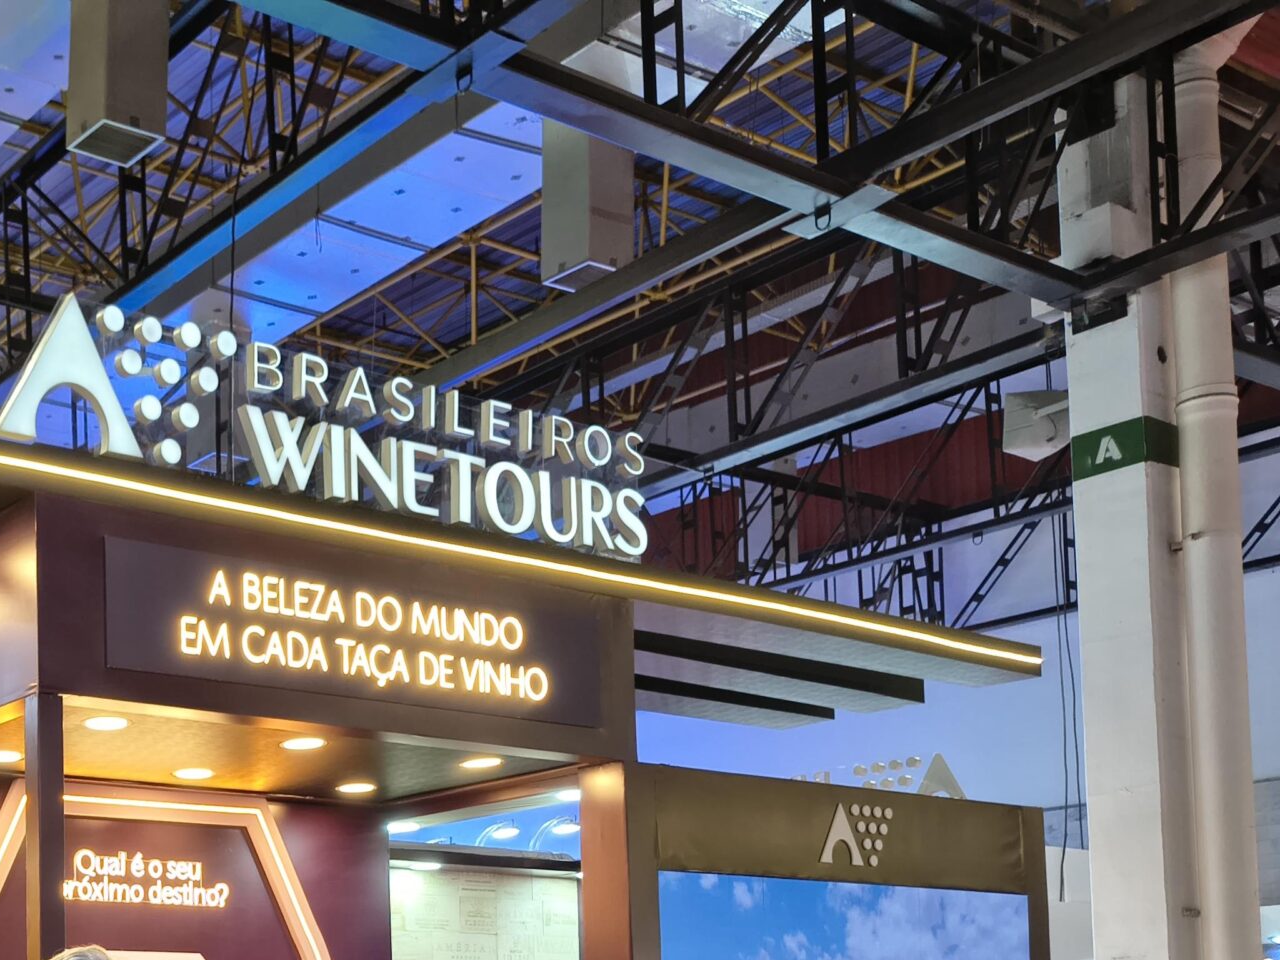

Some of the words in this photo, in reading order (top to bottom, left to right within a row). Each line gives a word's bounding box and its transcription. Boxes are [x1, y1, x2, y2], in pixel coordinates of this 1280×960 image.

[246, 341, 645, 477] BRASILEIROS
[1095, 435, 1122, 464] A
[238, 404, 649, 557] WINETOURS
[208, 570, 231, 607] A
[242, 572, 345, 624] BELEZA
[355, 592, 402, 632] DO
[412, 602, 524, 651] MUNDO
[180, 616, 231, 660] EM
[242, 625, 329, 671] CADA
[336, 638, 410, 688] TAÇA
[420, 653, 455, 691] DE
[461, 657, 549, 702] VINHO
[75, 849, 126, 877] Qual
[130, 851, 144, 878] é
[148, 860, 163, 880] o
[166, 861, 202, 881] seu
[148, 876, 230, 908] destino?
